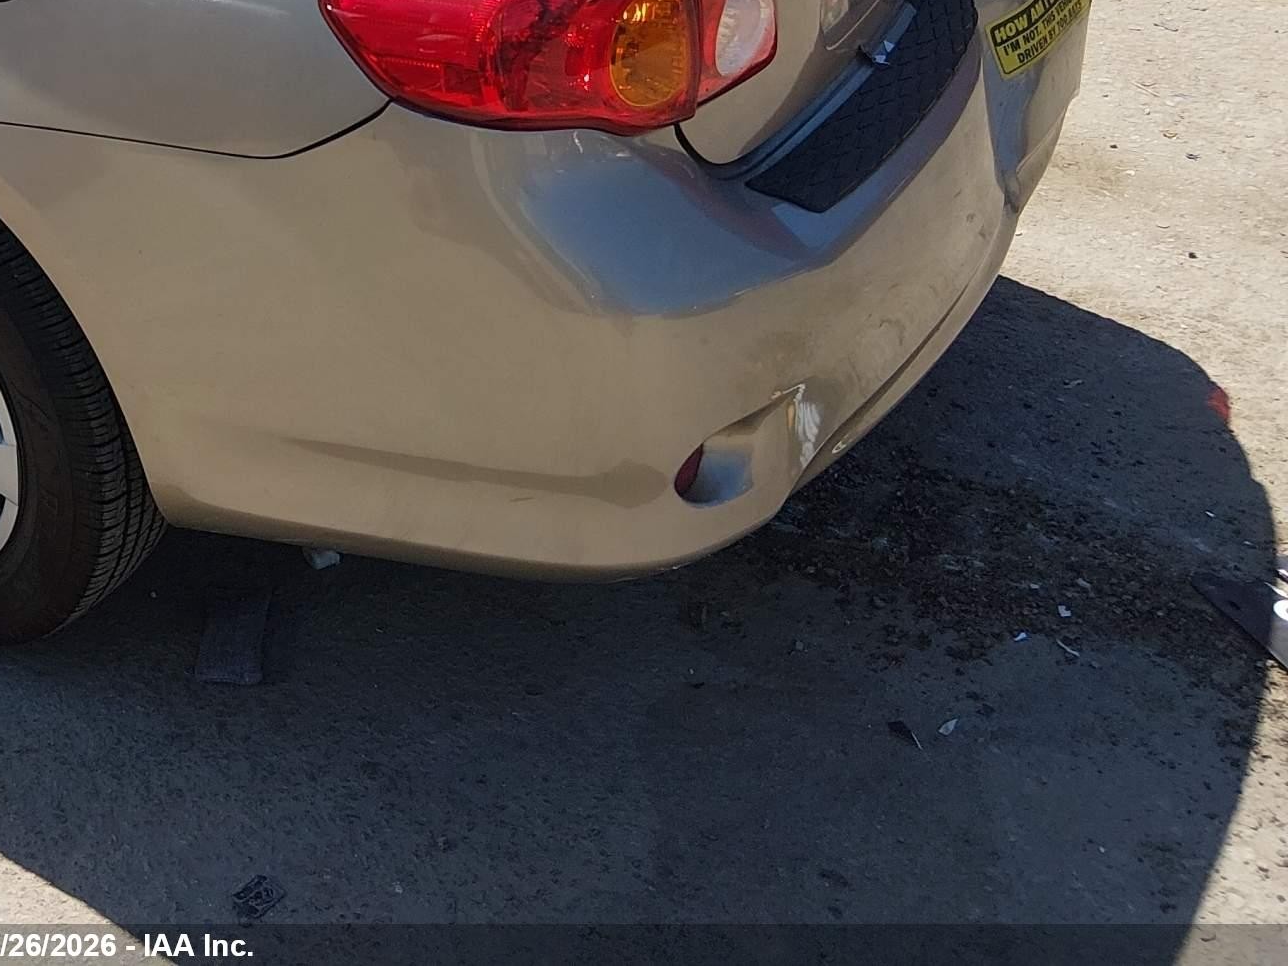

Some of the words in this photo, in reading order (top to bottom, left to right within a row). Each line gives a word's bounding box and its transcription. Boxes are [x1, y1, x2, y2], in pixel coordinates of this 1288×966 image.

[993, 13, 1028, 44] HOW
[1031, 0, 1045, 23] AM
[1002, 38, 1021, 57] I'M
[1042, 10, 1056, 31] THIS
[1016, 35, 1048, 64] DRIVEN
